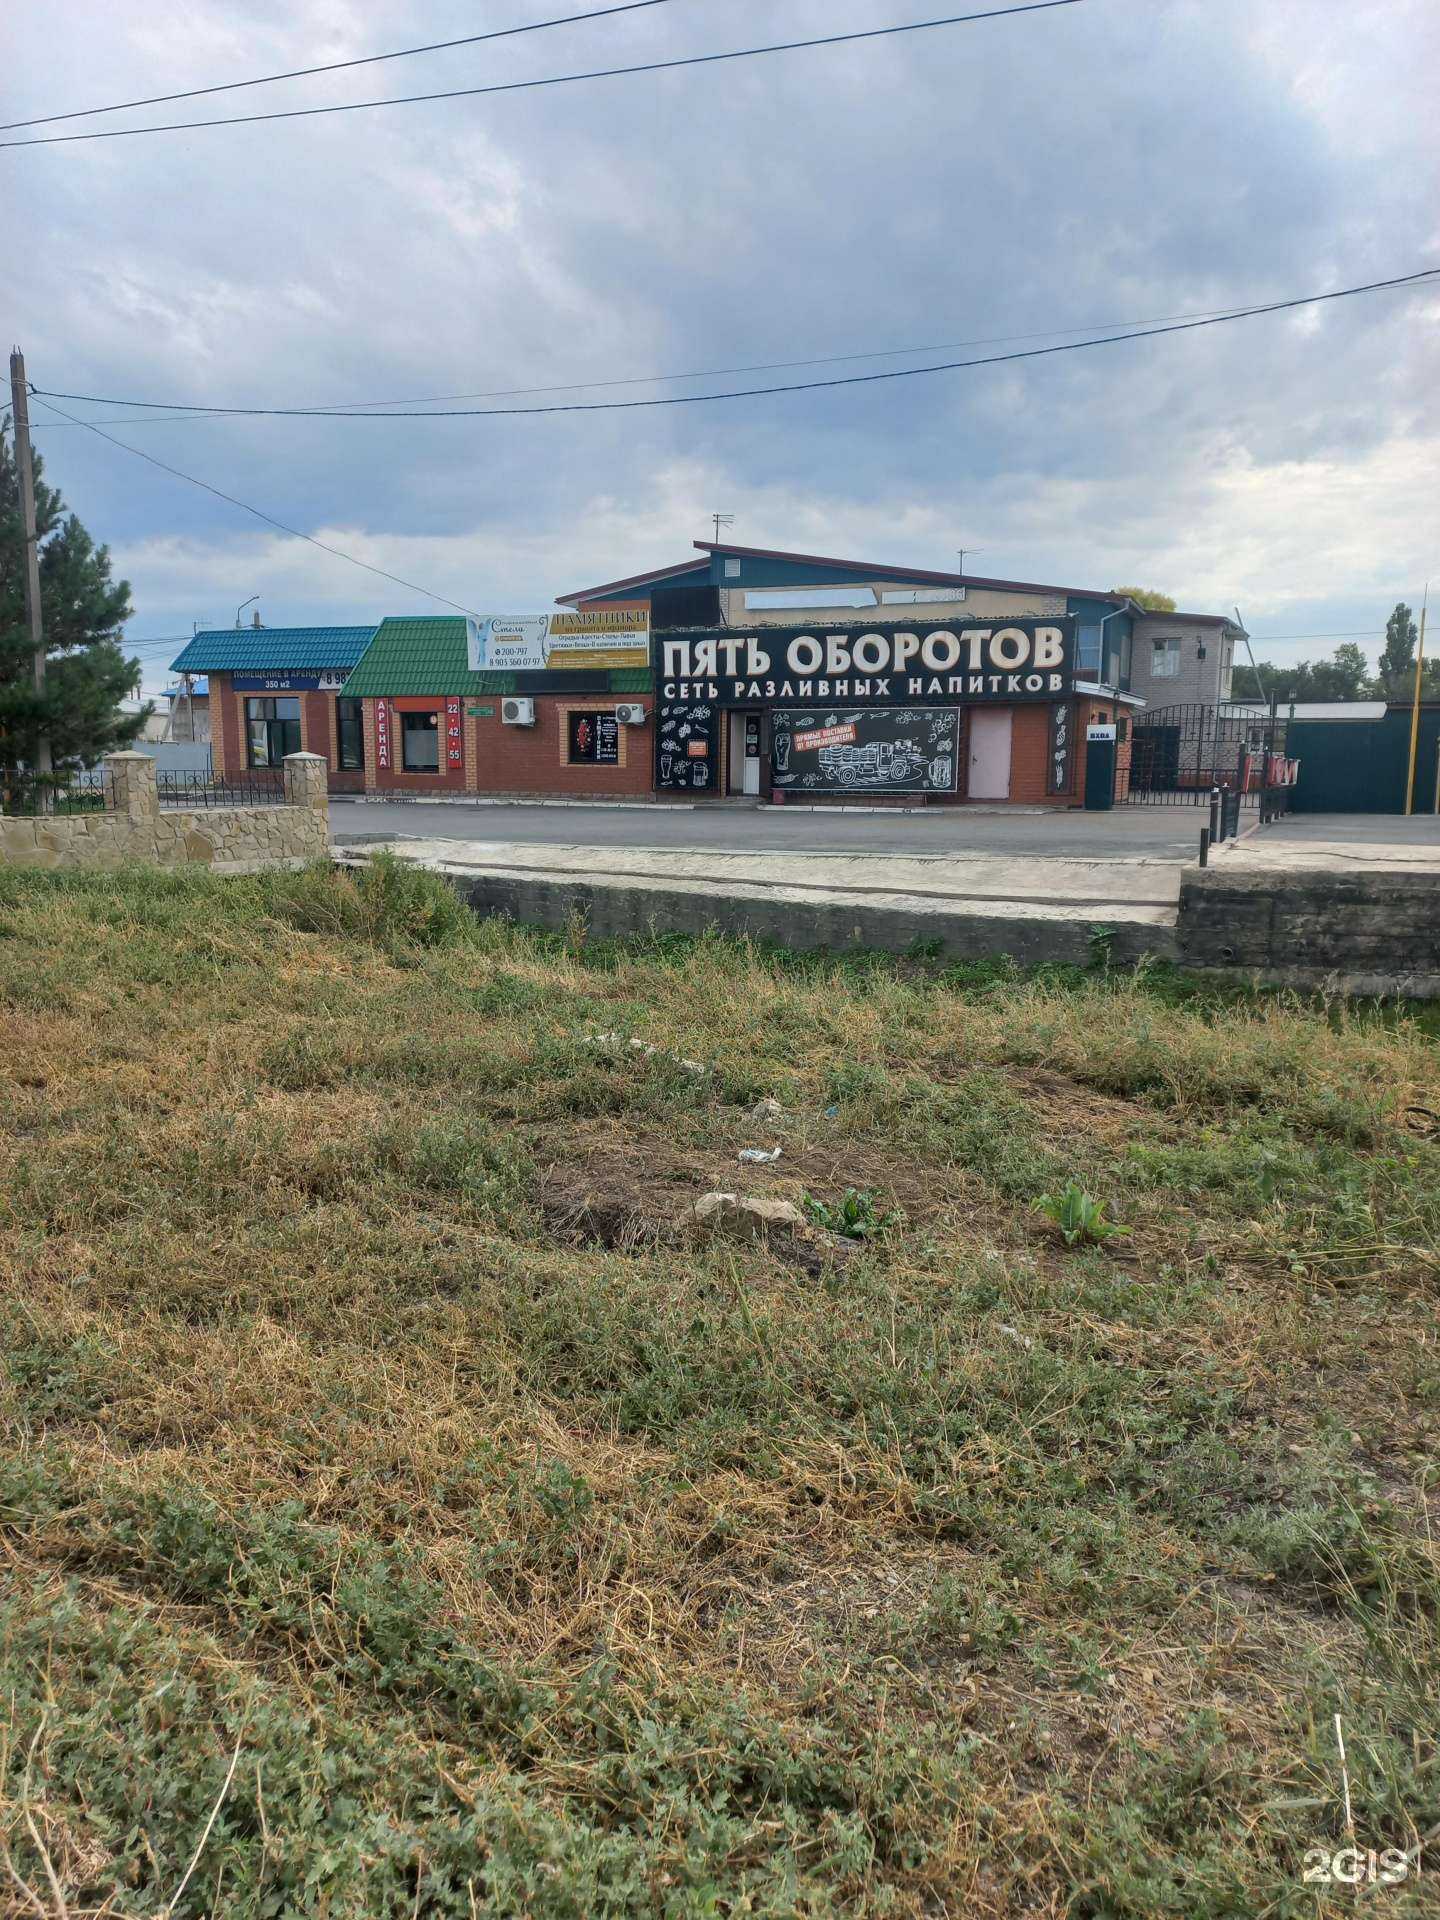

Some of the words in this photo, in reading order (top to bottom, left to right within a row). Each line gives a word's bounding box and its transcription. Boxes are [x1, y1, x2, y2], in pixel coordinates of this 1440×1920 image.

[556, 611, 645, 624] ПАМЯТНИКИ
[663, 637, 771, 677] ПЯТЬ
[786, 627, 1064, 675] ОБОРОТОВ
[490, 658, 494, 666] 8
[523, 657, 531, 665] 07
[532, 657, 541, 665] 97
[234, 670, 281, 679] ПОМЕЩЕНИЕ
[291, 670, 321, 679] АРЕНДУ
[326, 673, 332, 685] 8
[265, 680, 278, 688] 350
[664, 683, 719, 699] СЕТЬ
[734, 678, 891, 698] РАЗЛИВНЫХ
[909, 674, 1063, 695] НАПИТКОВ
[447, 704, 459, 714] 22
[378, 701, 388, 766] АРЕНДА
[448, 728, 459, 737] 42
[796, 731, 821, 742] ПРЯМЫЕ
[822, 725, 852, 737] ПОСТАВКИ
[806, 732, 856, 748] ПРОИЗВОДИТЕЛЯ
[449, 750, 460, 760] 55
